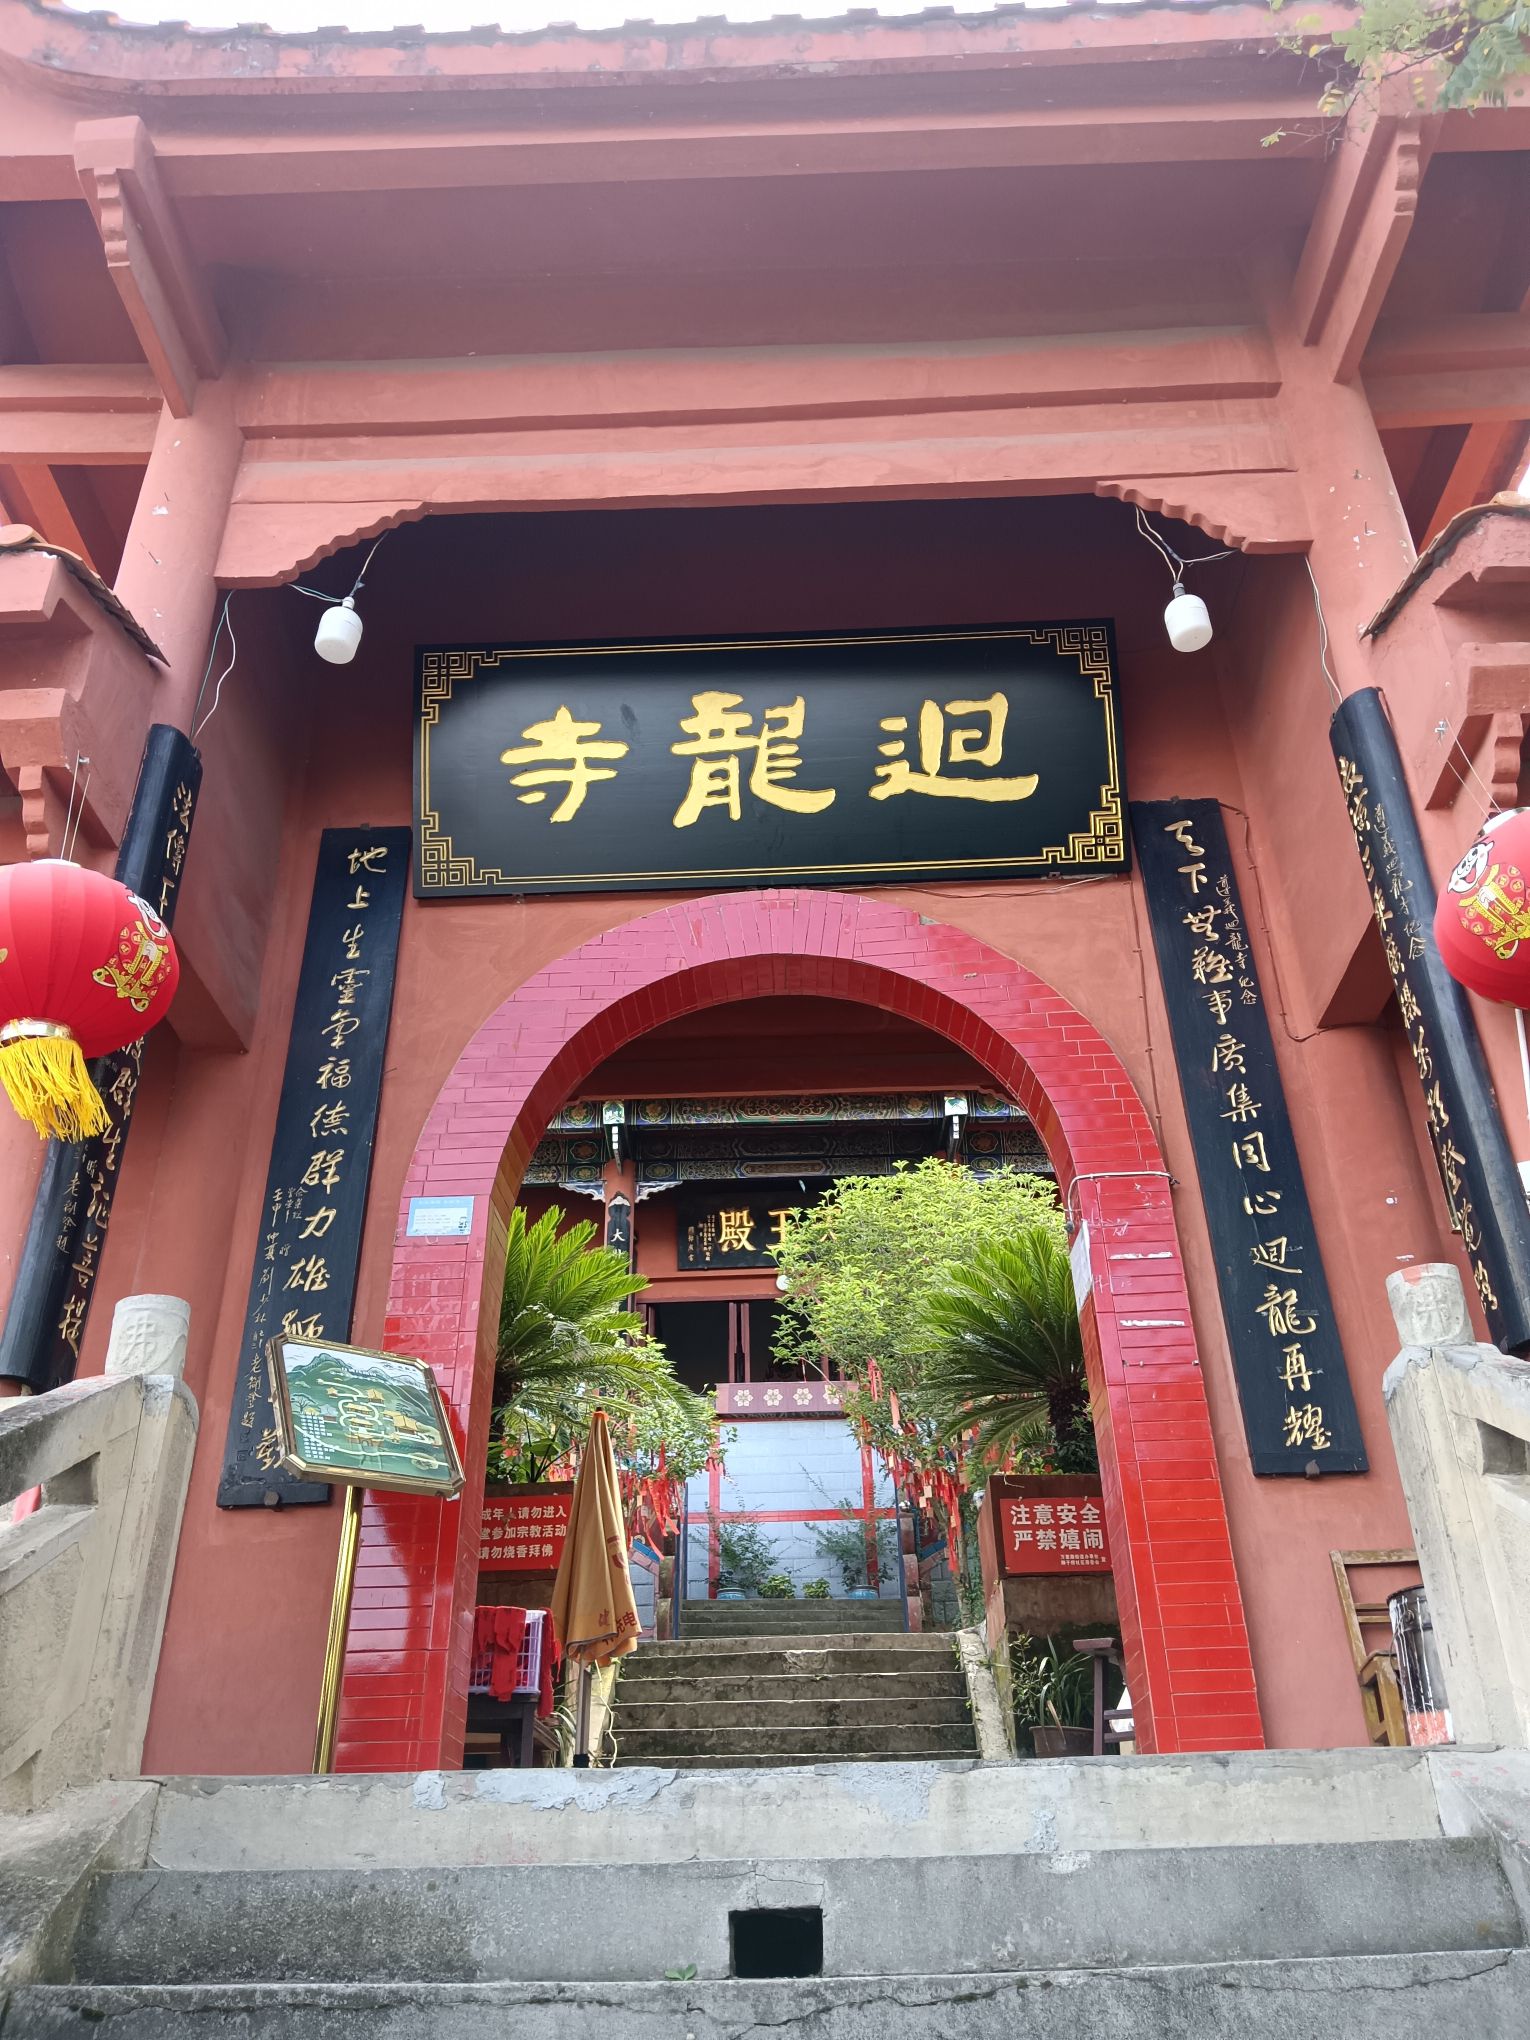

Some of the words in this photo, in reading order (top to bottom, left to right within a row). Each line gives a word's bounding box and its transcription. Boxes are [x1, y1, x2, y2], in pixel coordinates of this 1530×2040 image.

[1010, 1503, 1100, 1526] 注意安全
[1013, 1528, 1104, 1551] 严禁嬉闹
[480, 1543, 553, 1560] 请勿烧香拜佛
